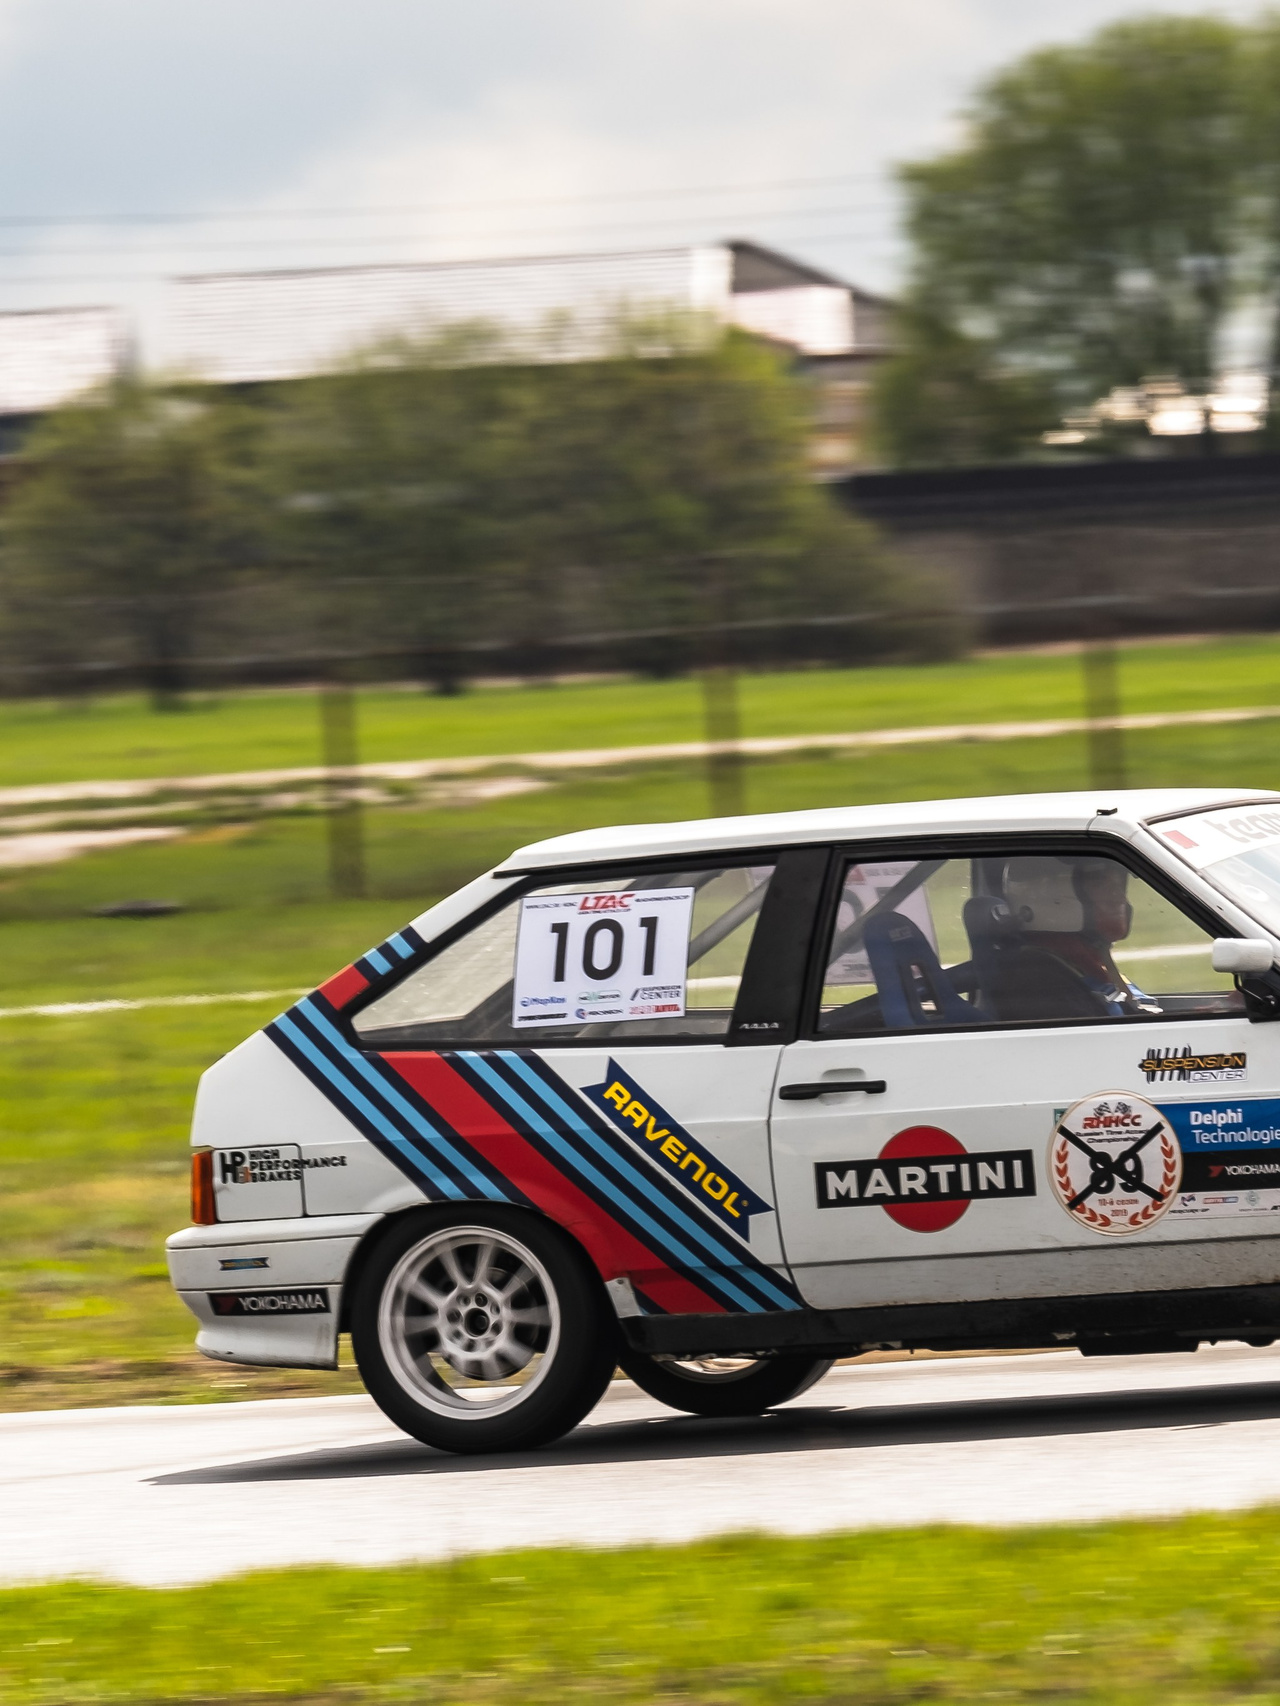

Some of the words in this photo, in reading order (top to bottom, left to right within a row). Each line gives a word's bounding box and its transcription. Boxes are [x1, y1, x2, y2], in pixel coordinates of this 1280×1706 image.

[580, 894, 635, 911] LTAC
[551, 916, 659, 982] 101
[641, 990, 681, 1000] CENTER
[1142, 1054, 1245, 1071] SUSPENSION
[1192, 1070, 1244, 1081] CENTER
[1083, 1114, 1142, 1129] RHHCC
[1190, 1109, 1243, 1127] Delphi
[248, 1149, 280, 1160] HIGH
[603, 1081, 740, 1218] RAVENOL
[249, 1156, 347, 1171] PERFORMANCE
[250, 1170, 302, 1183] BRAKES
[826, 1160, 1024, 1200] MARTINI
[239, 1293, 325, 1311] YOKOHAMA
